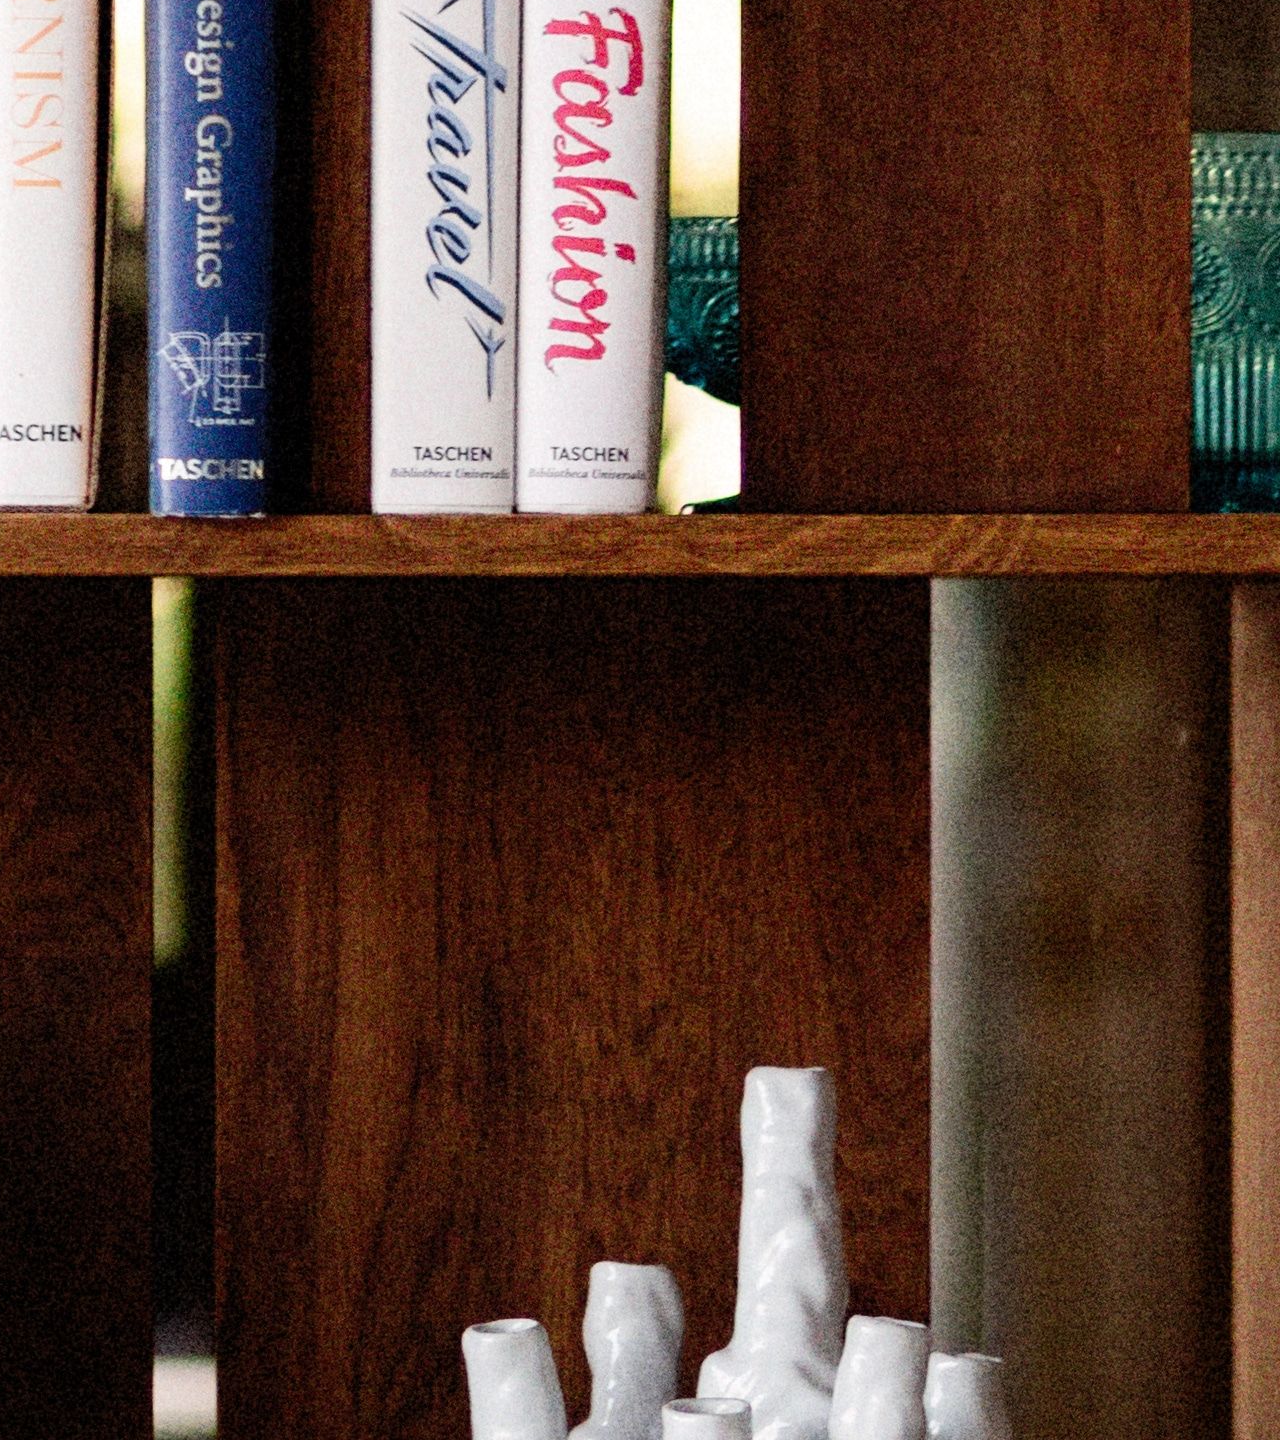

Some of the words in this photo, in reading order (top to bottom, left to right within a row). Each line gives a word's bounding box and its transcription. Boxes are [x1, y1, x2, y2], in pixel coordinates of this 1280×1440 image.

[185, 113, 235, 290] Graphics
[541, 6, 646, 378] Fashion
[413, 446, 493, 462] TASCHEN
[550, 446, 630, 462] TASCHEN
[157, 458, 264, 481] TASCHEN
[390, 467, 451, 480] Bibliotheca
